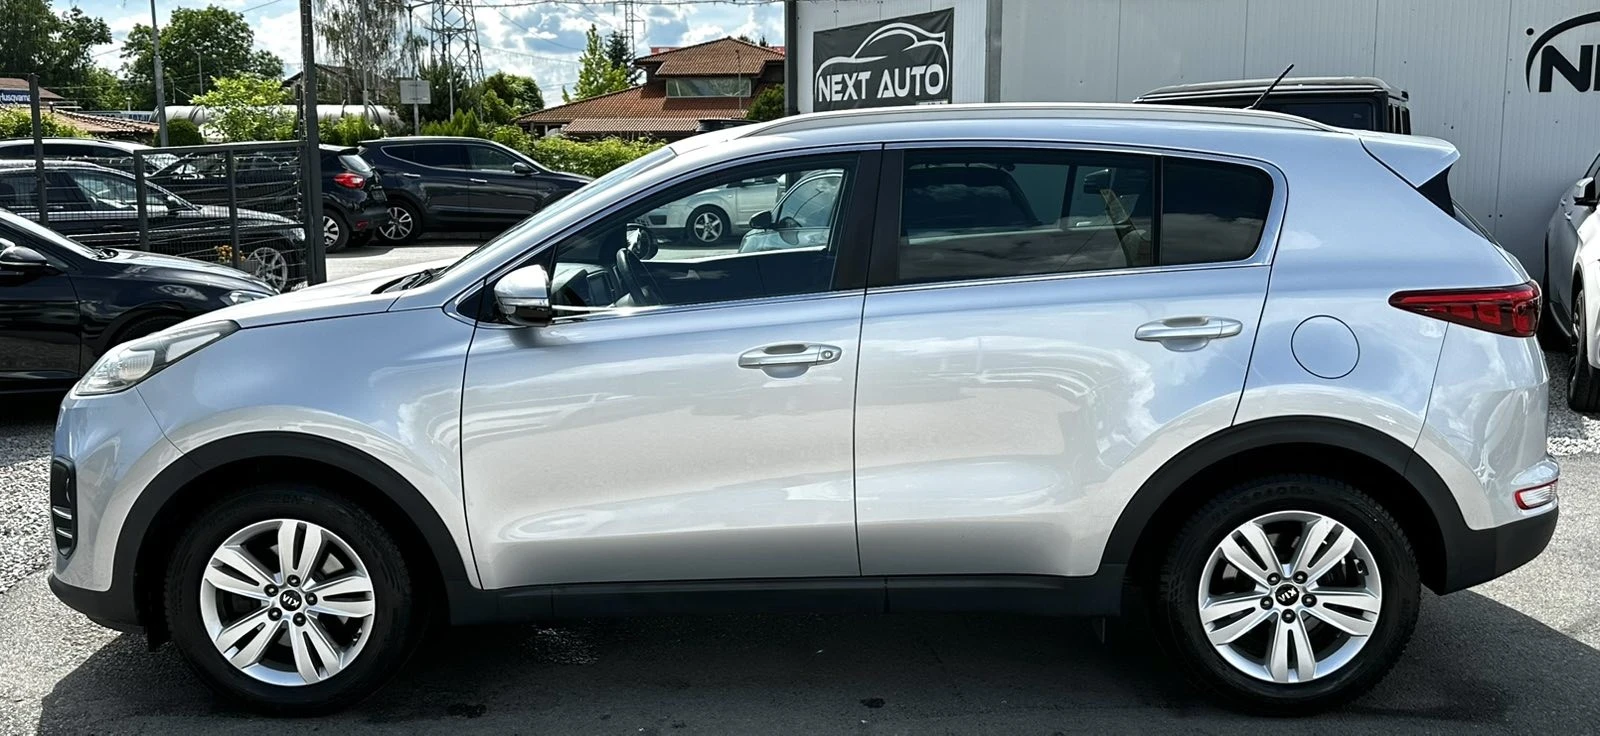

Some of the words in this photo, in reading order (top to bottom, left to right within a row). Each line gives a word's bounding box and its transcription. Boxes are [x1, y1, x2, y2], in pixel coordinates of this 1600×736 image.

[1539, 44, 1600, 93] N
[818, 71, 872, 102] NEXT
[877, 63, 944, 99] AUTO
[282, 593, 300, 608] KIA
[1278, 587, 1297, 601] KIA
